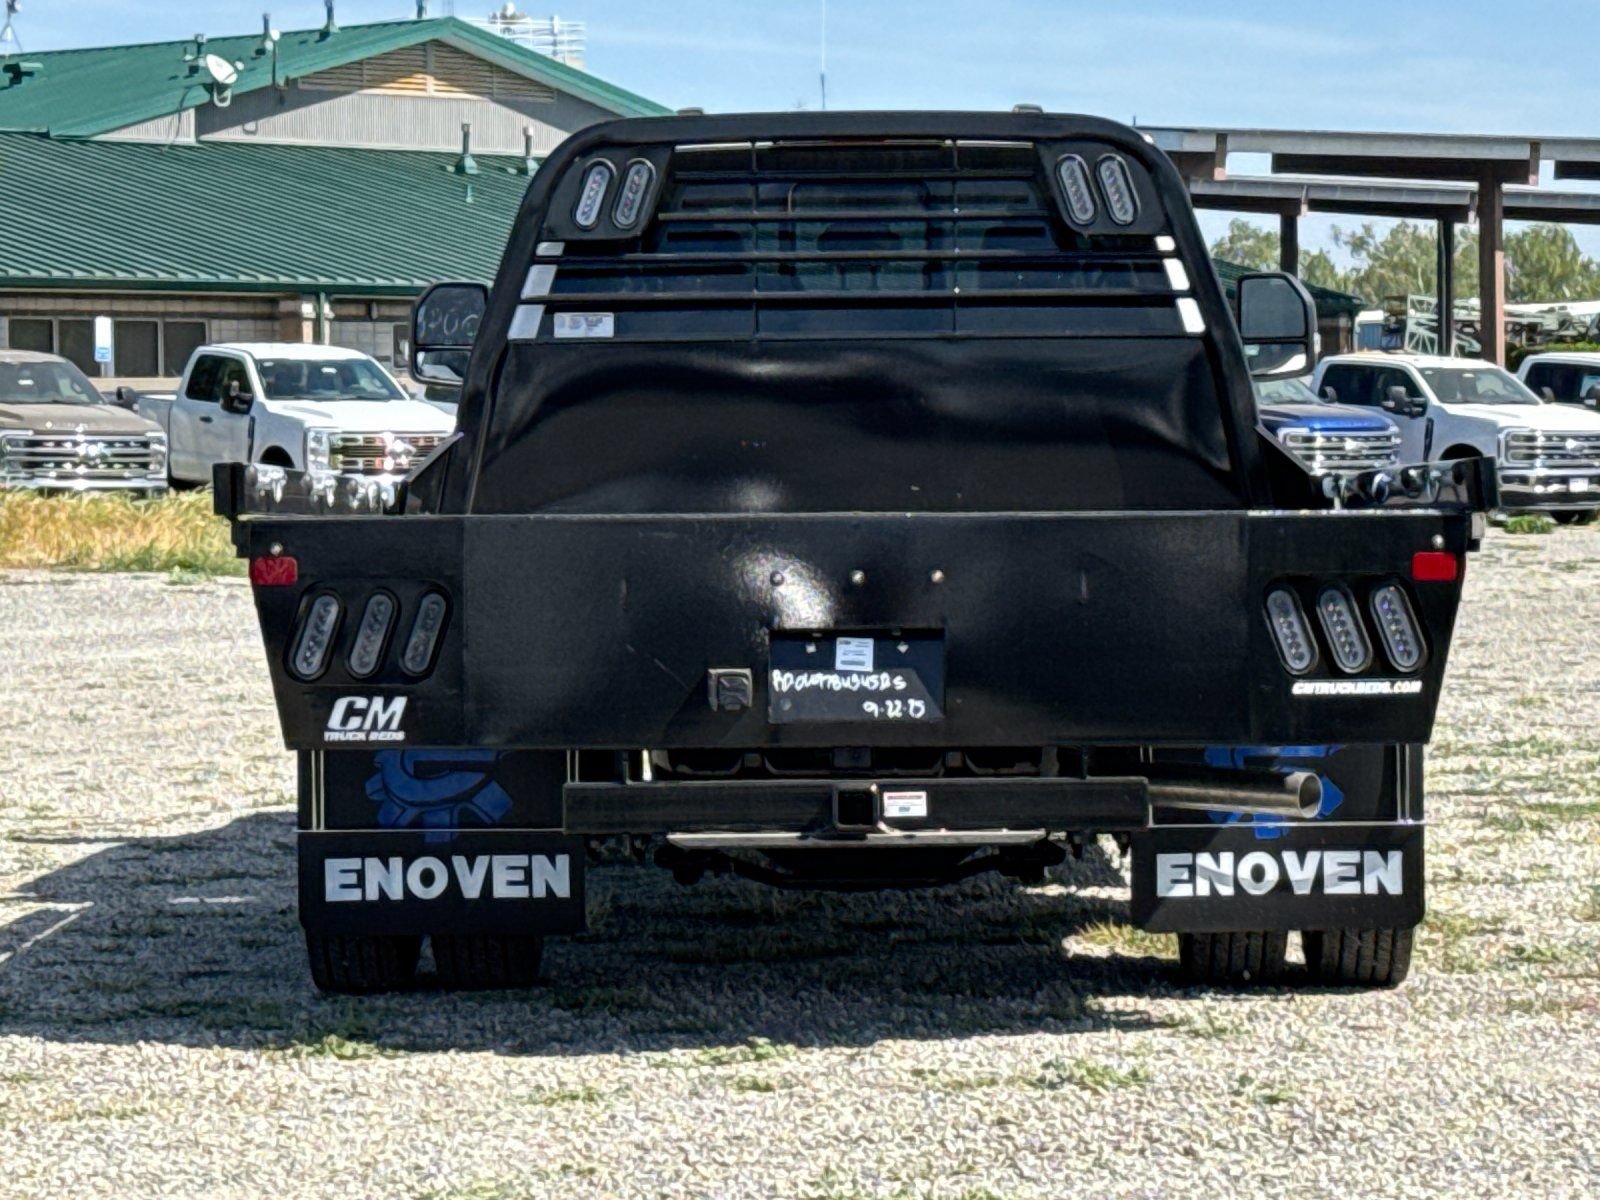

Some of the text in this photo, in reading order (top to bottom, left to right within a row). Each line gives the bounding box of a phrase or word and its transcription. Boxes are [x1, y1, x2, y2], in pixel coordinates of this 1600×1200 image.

[326, 696, 409, 730] CM
[323, 731, 367, 741] TRUCK
[324, 854, 571, 902] ENOVEN
[1156, 850, 1404, 897] ENOVEN
